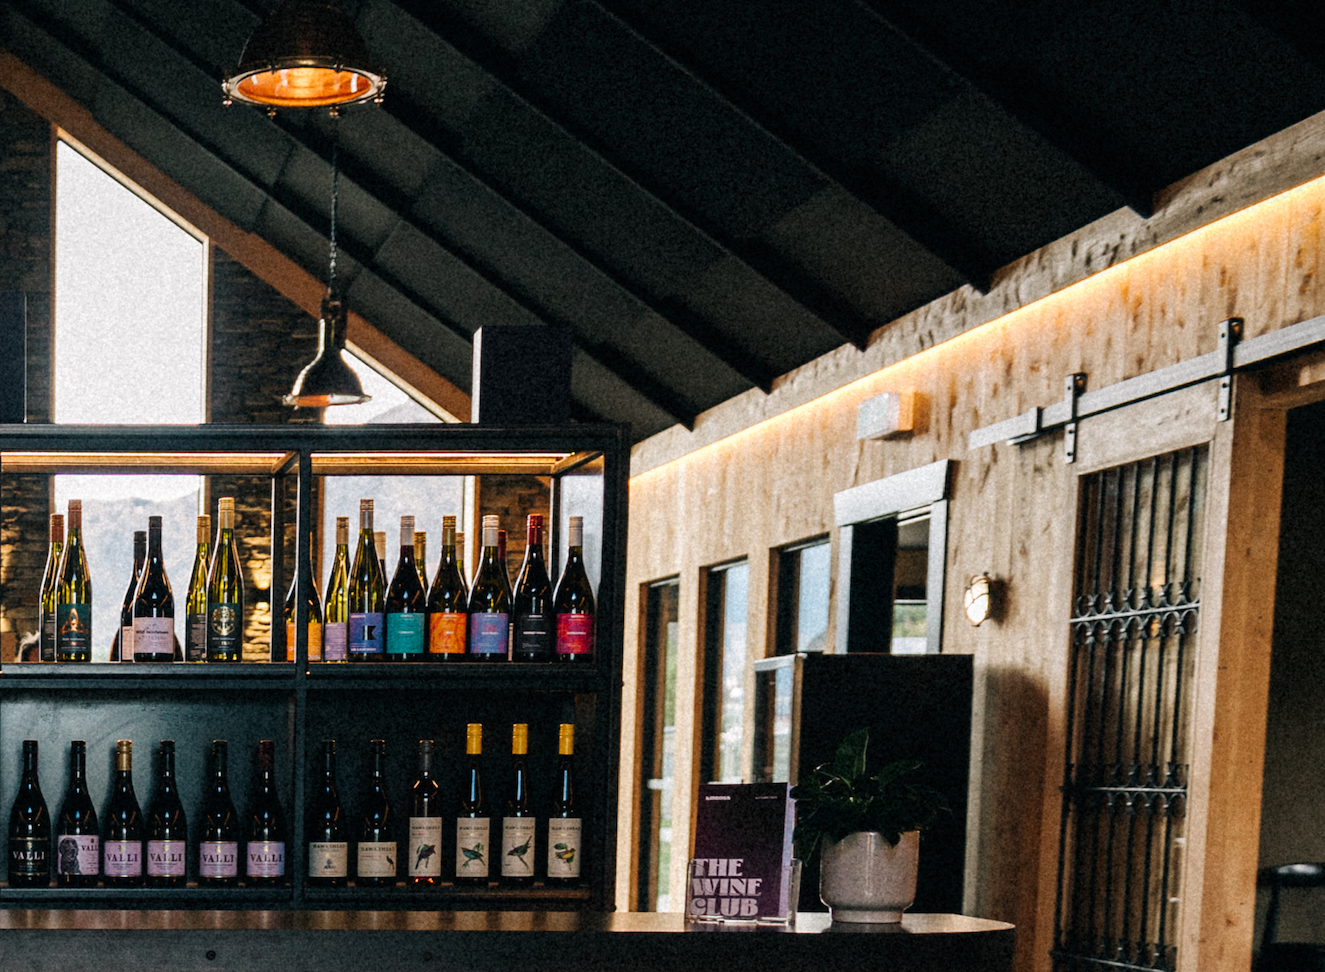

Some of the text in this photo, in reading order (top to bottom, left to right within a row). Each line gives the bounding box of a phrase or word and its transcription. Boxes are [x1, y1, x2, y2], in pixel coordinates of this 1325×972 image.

[13, 852, 44, 860] VALLI
[107, 854, 137, 862] VALLI
[250, 854, 282, 862] VALLI
[693, 858, 743, 876] THE
[693, 878, 762, 896] WINE
[691, 898, 758, 917] CLUB
